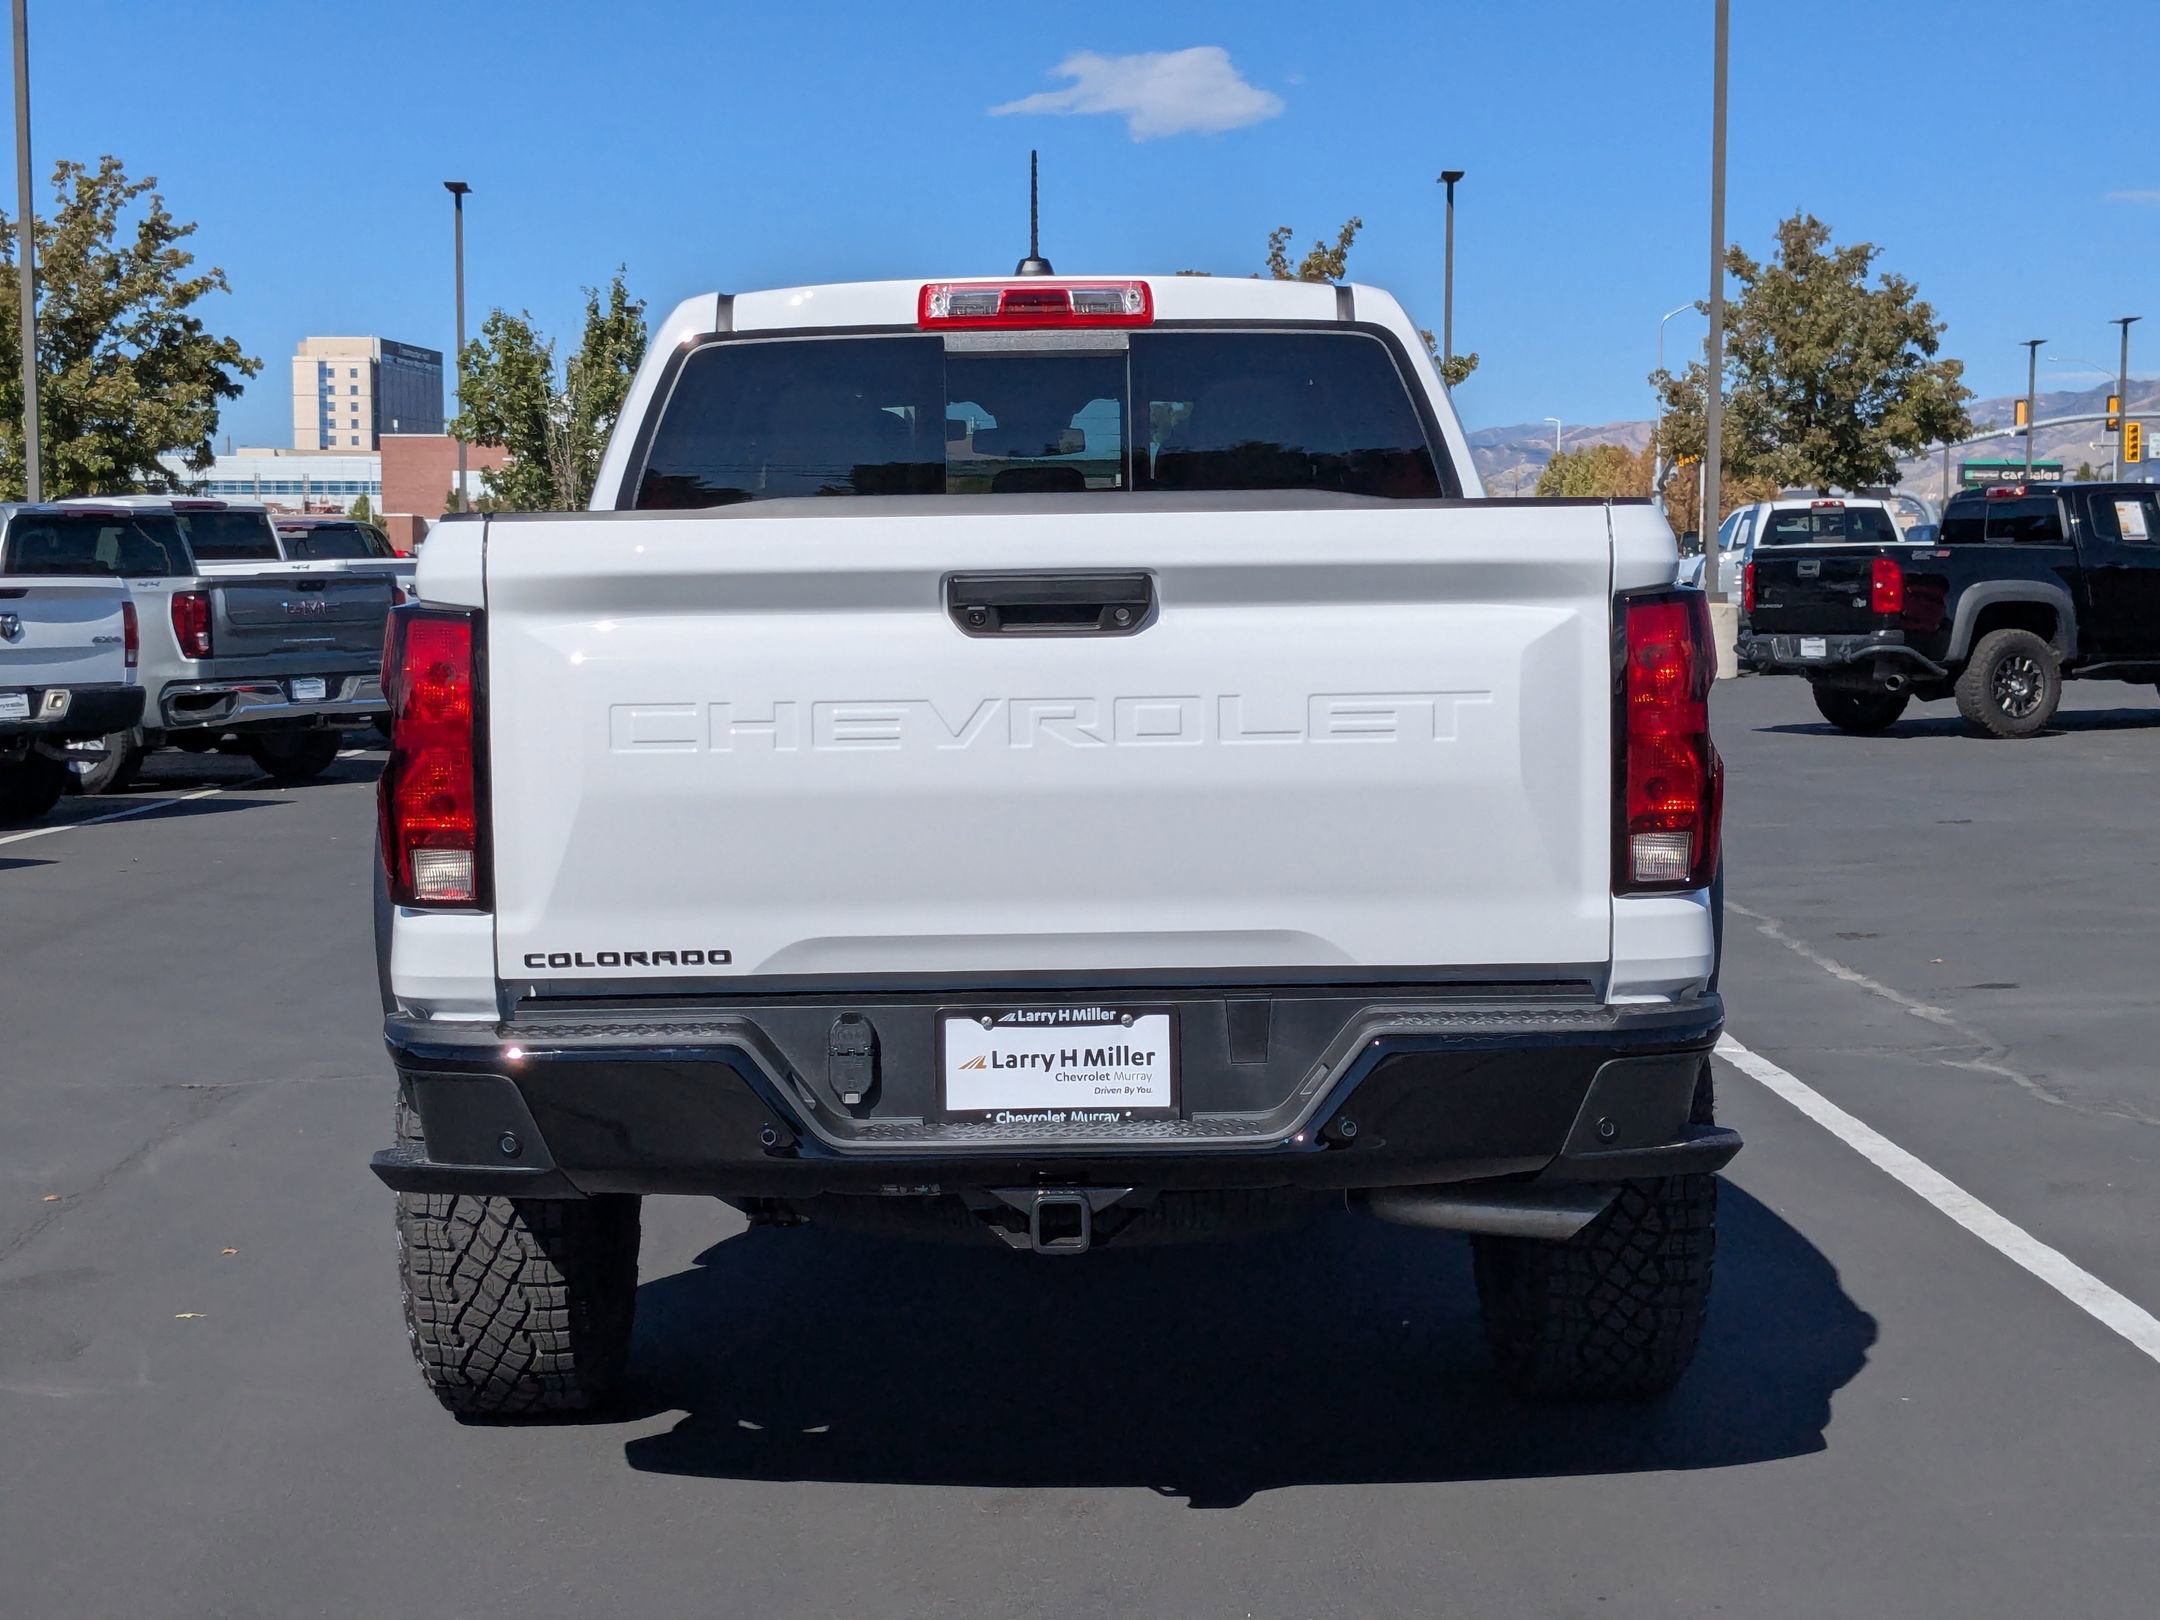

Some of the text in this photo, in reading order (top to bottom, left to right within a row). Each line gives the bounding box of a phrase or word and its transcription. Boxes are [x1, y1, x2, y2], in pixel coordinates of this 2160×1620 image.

[2026, 469, 2060, 480] ales
[608, 690, 1492, 756] CHEVROLET
[523, 949, 733, 969] COLORADO
[1017, 1007, 1117, 1025] Larry H Miller
[991, 1045, 1156, 1073] Larry H Miller
[1055, 1071, 1153, 1083] Chevrolet Murray
[1094, 1086, 1122, 1095] Driven
[1124, 1086, 1135, 1097] By
[995, 1110, 1120, 1124] Chevrolet Murray
